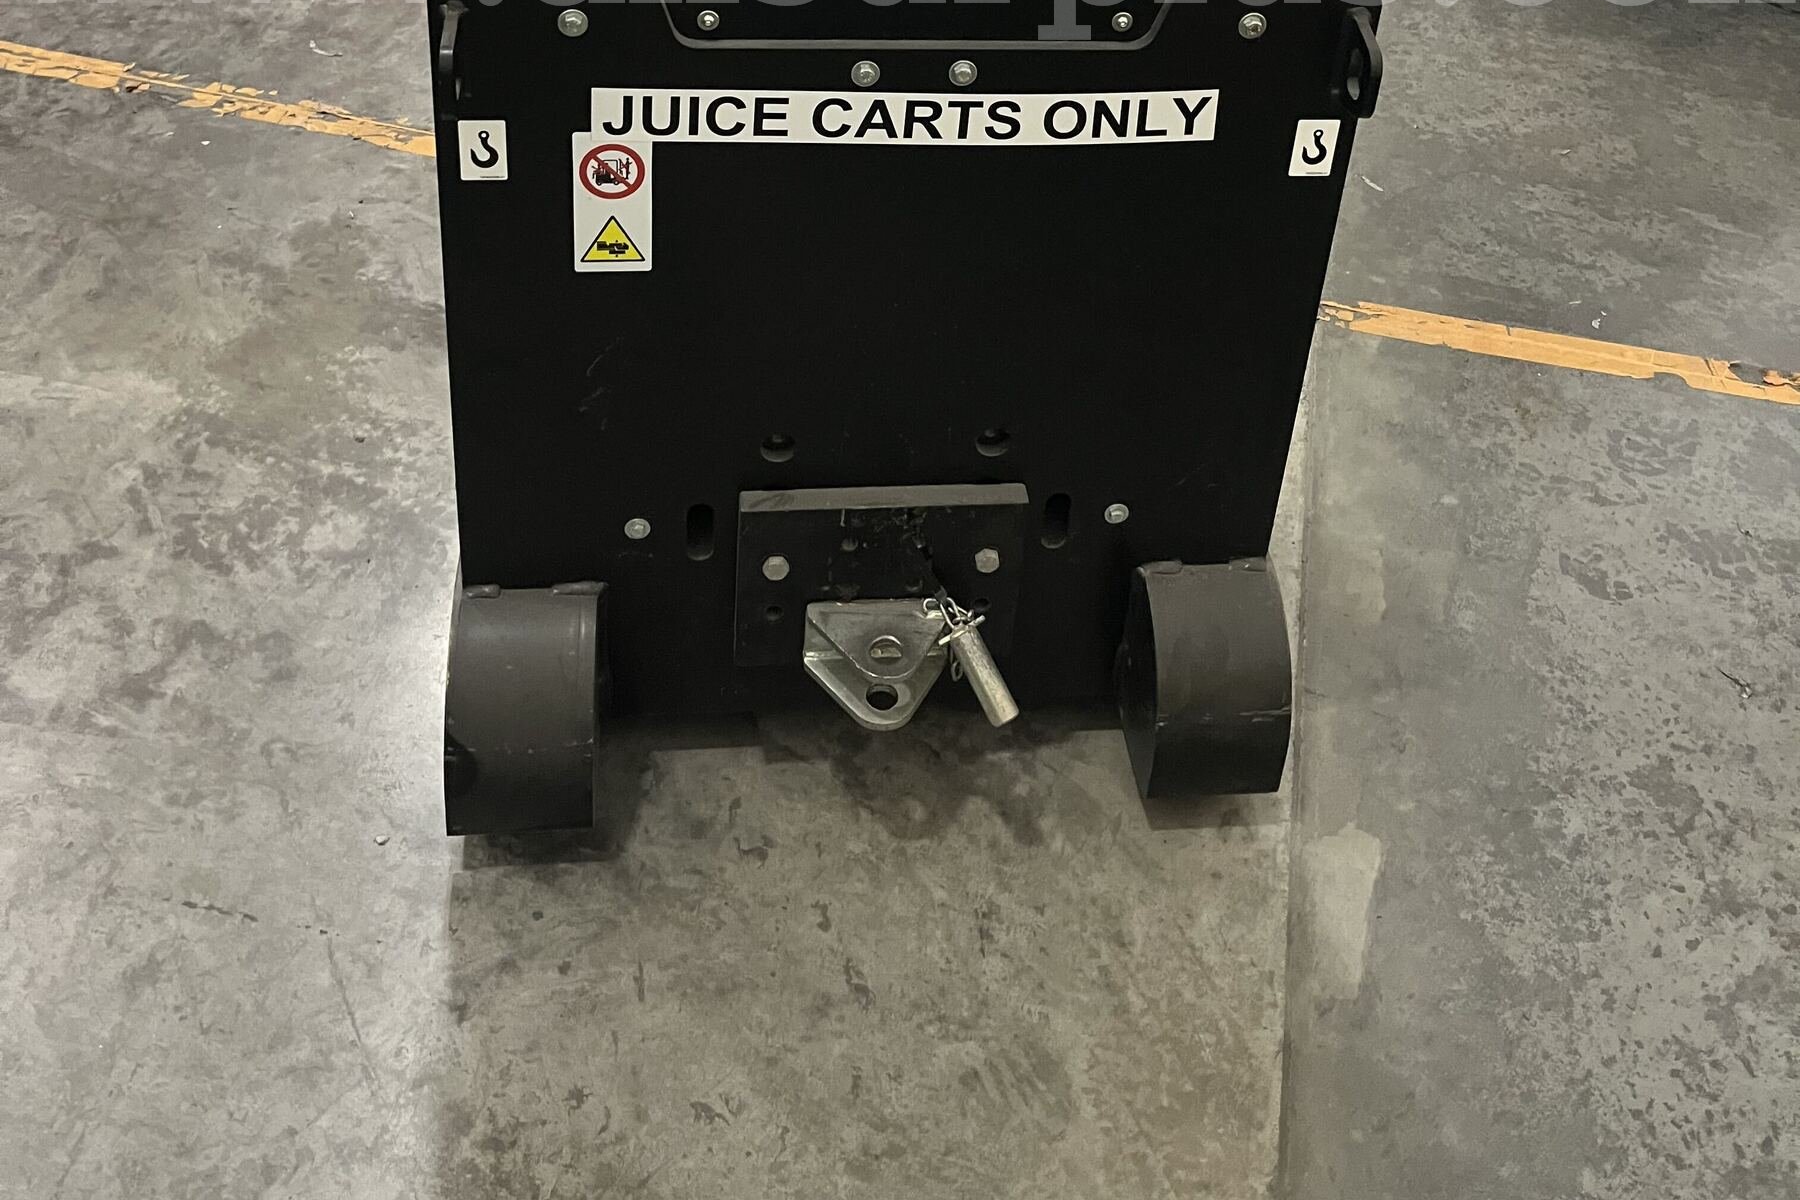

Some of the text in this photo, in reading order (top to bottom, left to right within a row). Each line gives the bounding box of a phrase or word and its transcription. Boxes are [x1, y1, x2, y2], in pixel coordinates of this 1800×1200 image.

[602, 95, 1213, 140] JUICE CARTS ONLY
